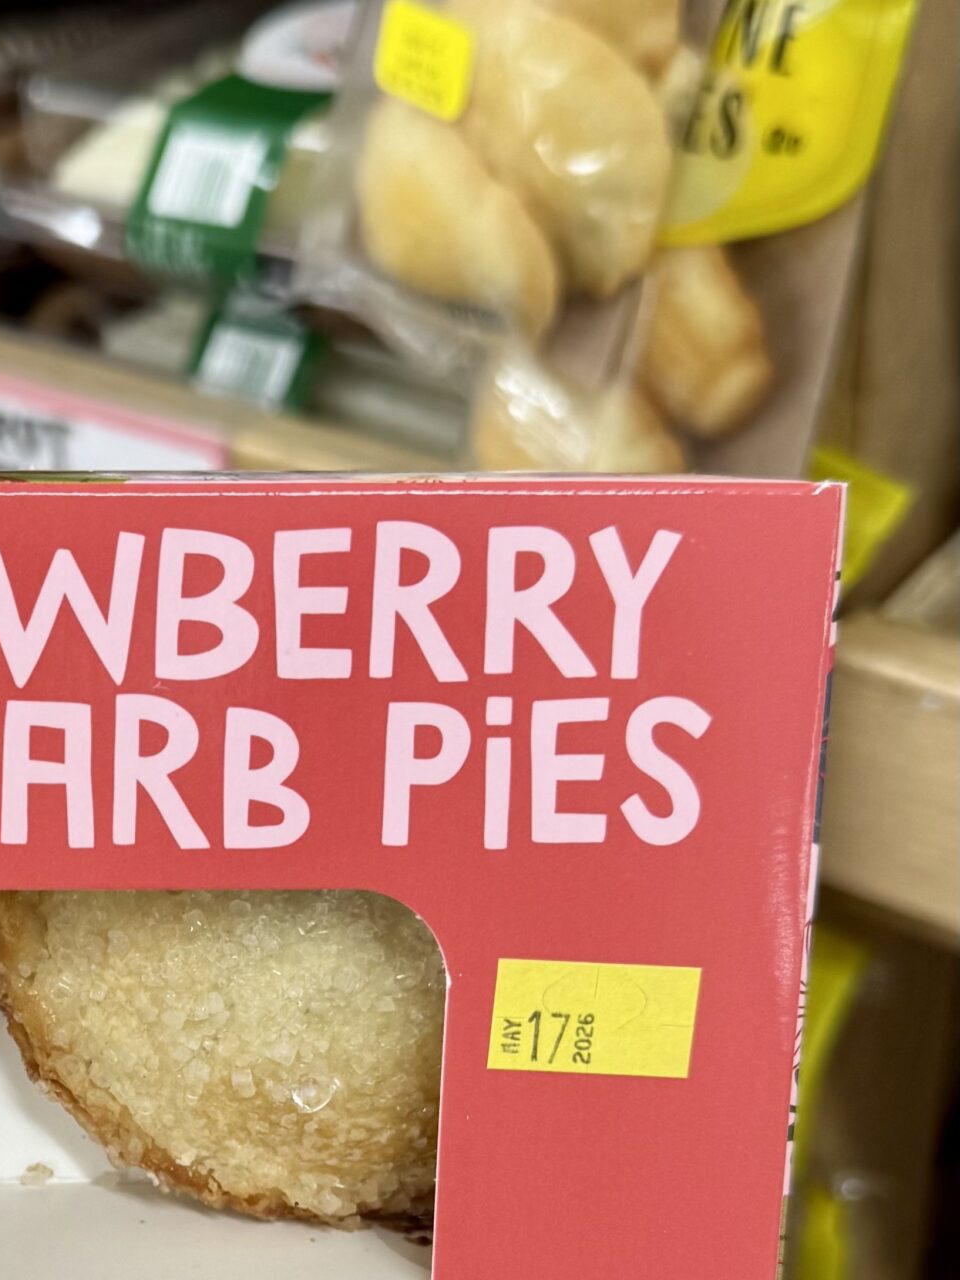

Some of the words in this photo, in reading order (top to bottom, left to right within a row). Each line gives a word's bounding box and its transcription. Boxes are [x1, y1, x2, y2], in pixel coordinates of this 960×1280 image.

[501, 1018, 522, 1054] MAY
[528, 1010, 570, 1064] 17
[572, 1013, 595, 1065] 2026
